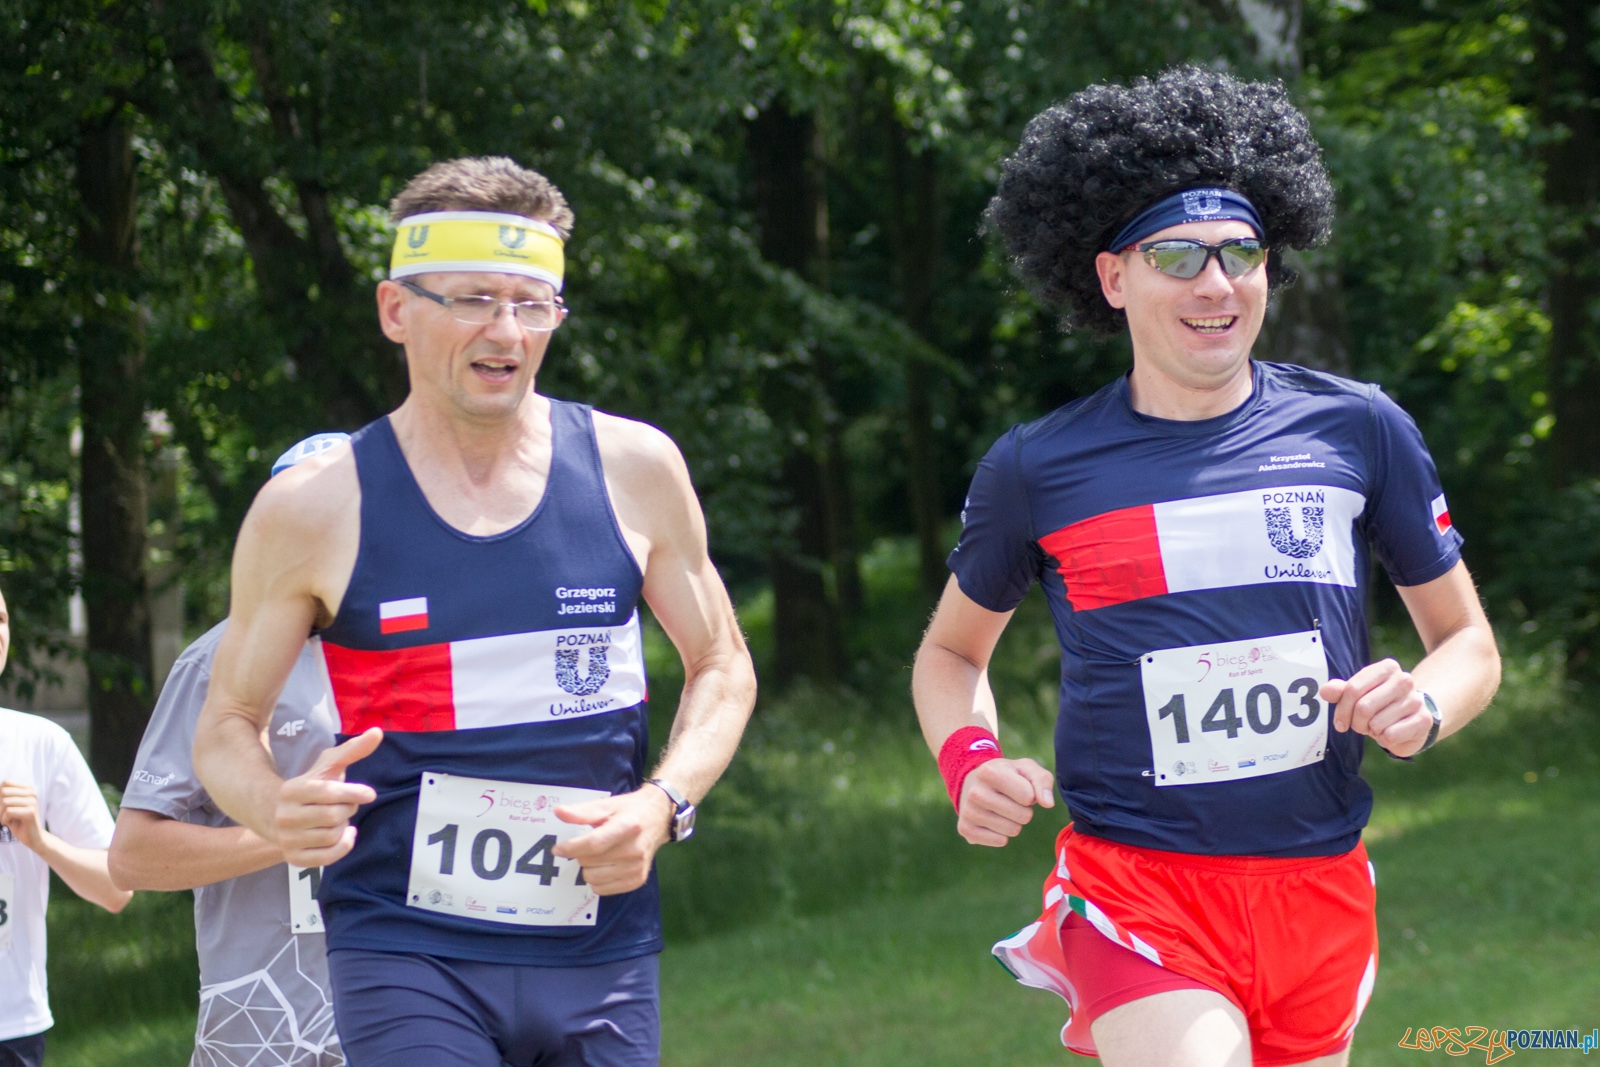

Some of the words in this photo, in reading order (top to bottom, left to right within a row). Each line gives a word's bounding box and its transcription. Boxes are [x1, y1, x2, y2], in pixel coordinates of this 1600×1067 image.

[1258, 461, 1326, 472] Aleksandrowicz
[1262, 489, 1325, 505] POZNAŃ
[1264, 563, 1331, 579] Unilever
[555, 587, 616, 601] Grzegorz
[557, 602, 616, 616] Jezierski
[1216, 652, 1248, 670] bieg
[549, 698, 614, 717] Unilever
[1157, 676, 1321, 744] 1403
[499, 791, 532, 815] bieg
[427, 823, 591, 886] 104
